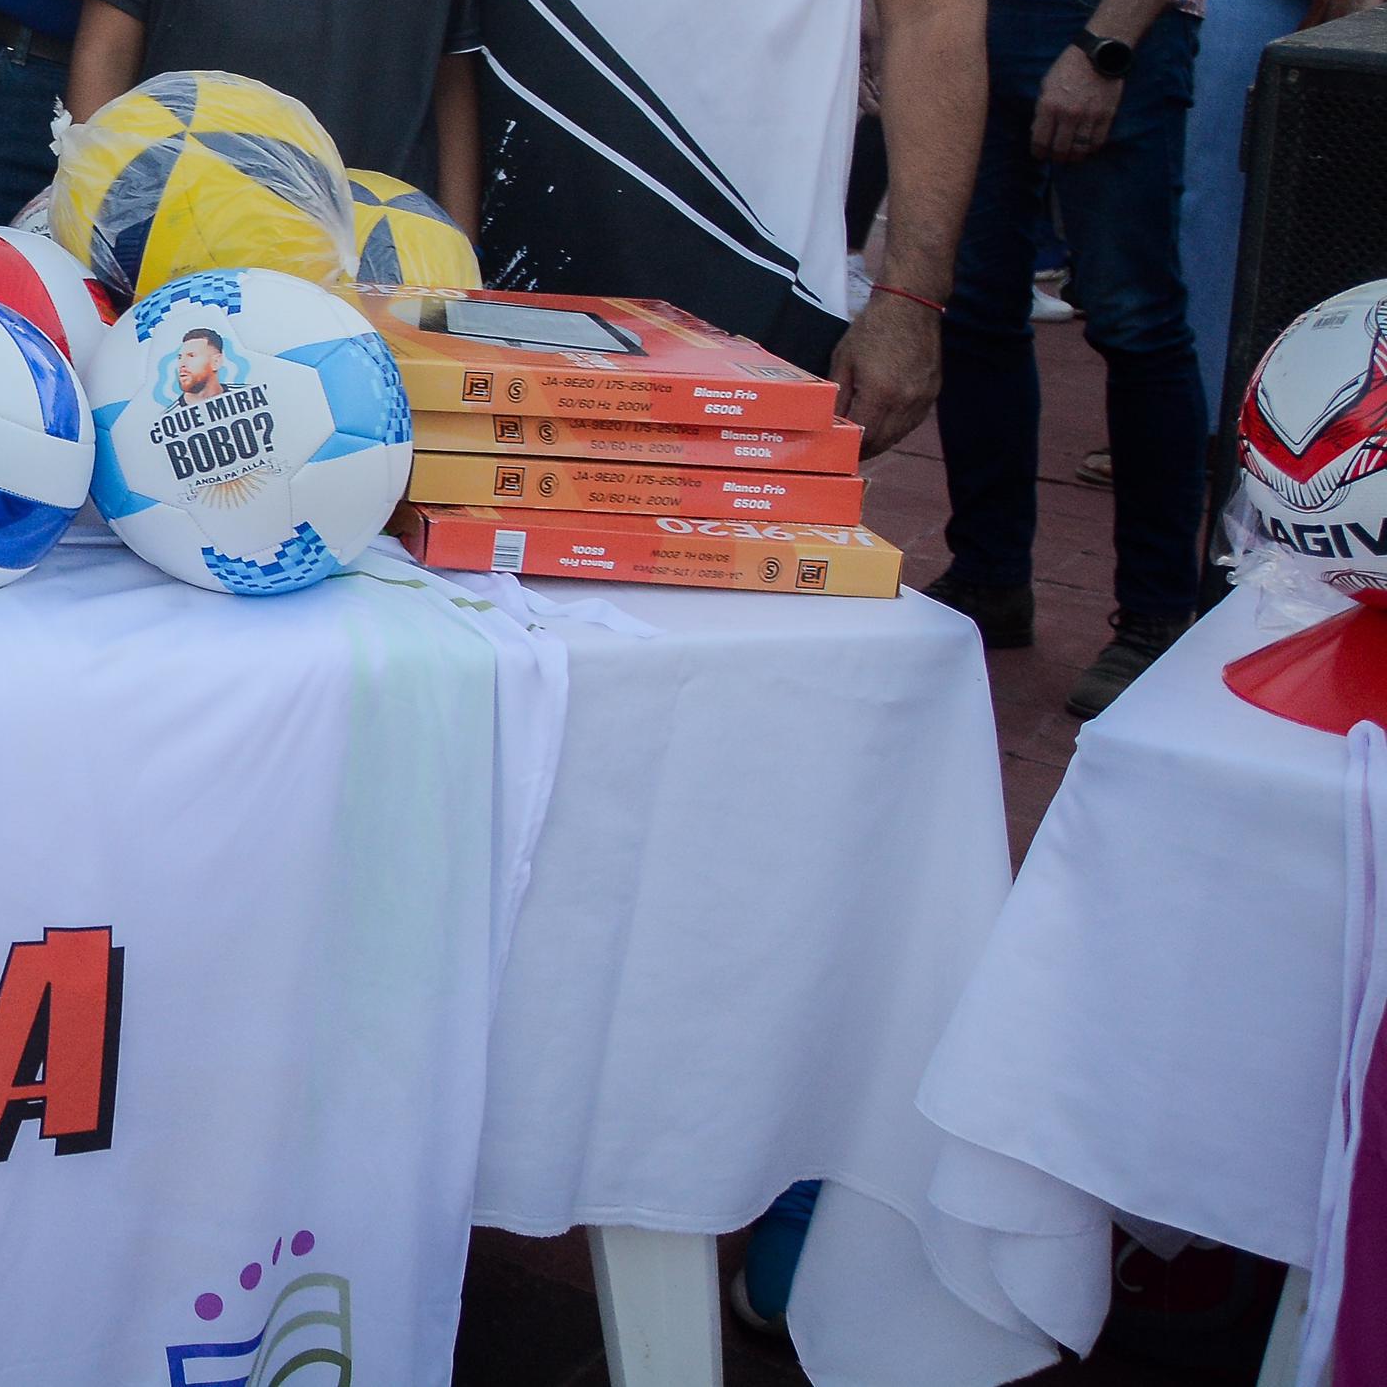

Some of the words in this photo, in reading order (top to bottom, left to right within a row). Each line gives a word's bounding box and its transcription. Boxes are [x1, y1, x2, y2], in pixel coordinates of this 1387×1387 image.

[693, 387, 733, 400] Blanco
[704, 404, 744, 416] 6500k
[721, 429, 759, 442] Blanco
[165, 411, 274, 480] BOBO?
[734, 446, 772, 458] 6500k
[195, 476, 222, 486] ANDA
[723, 481, 761, 494] Blanco
[733, 498, 772, 510] 6500k
